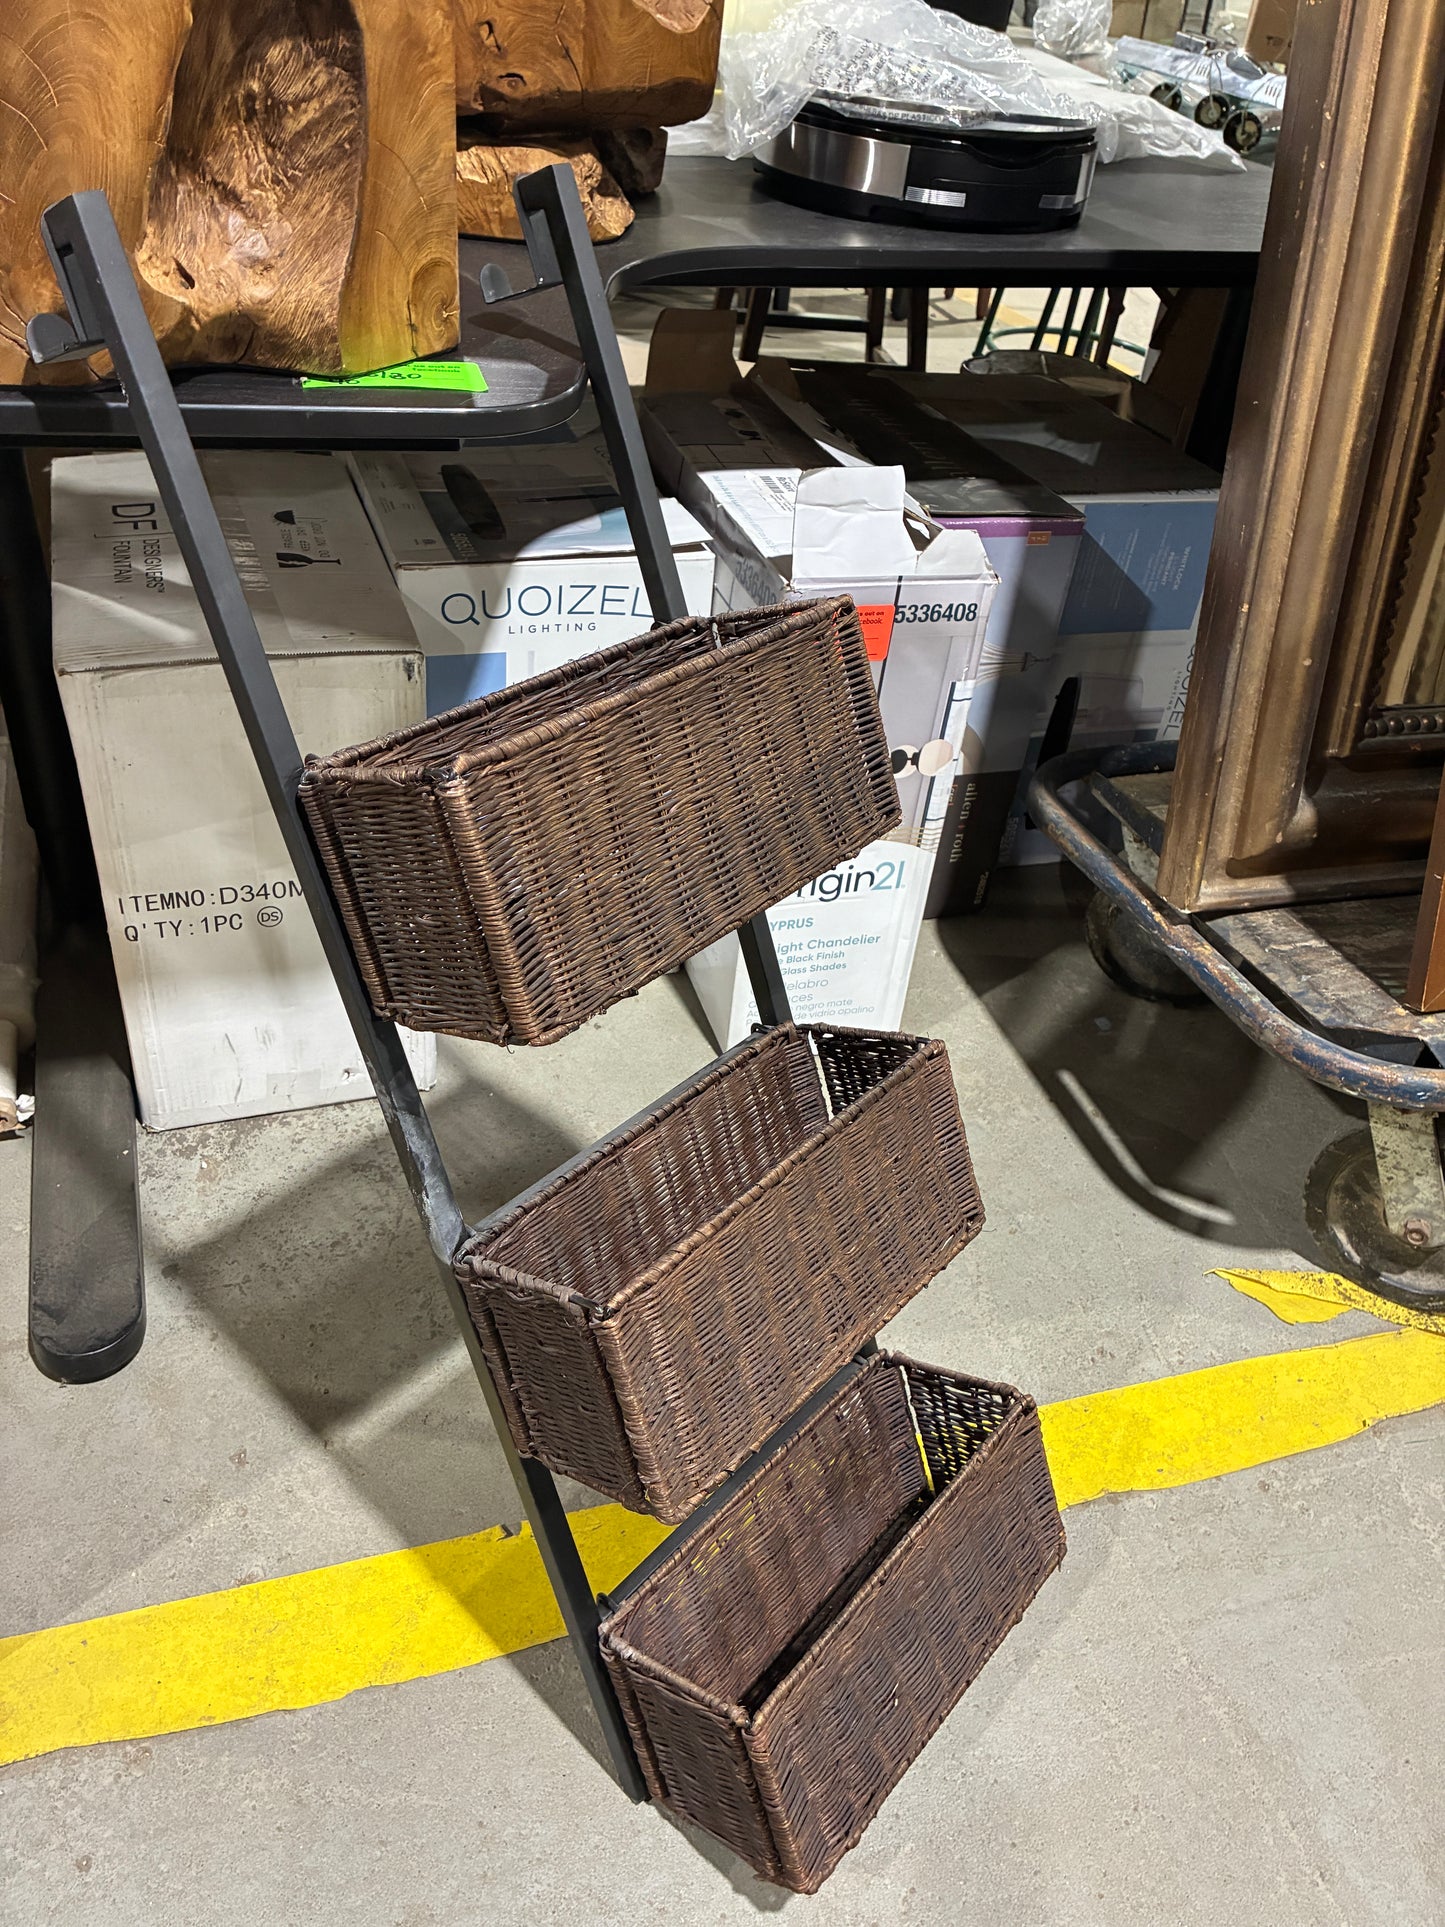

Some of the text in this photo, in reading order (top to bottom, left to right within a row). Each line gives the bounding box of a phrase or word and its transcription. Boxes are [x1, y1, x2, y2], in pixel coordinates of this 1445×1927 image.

[112, 503, 158, 531] DF
[441, 585, 654, 626] QUOIZEL
[895, 603, 978, 624] 5336408
[508, 622, 597, 635] LIGHTING
[959, 783, 978, 820] allen
[950, 833, 964, 863] roth
[770, 917, 814, 931] YPRUS
[777, 934, 881, 955] ight Chandelier
[786, 954, 814, 964] Black
[816, 950, 845, 960] Finish
[810, 962, 847, 973] Shades
